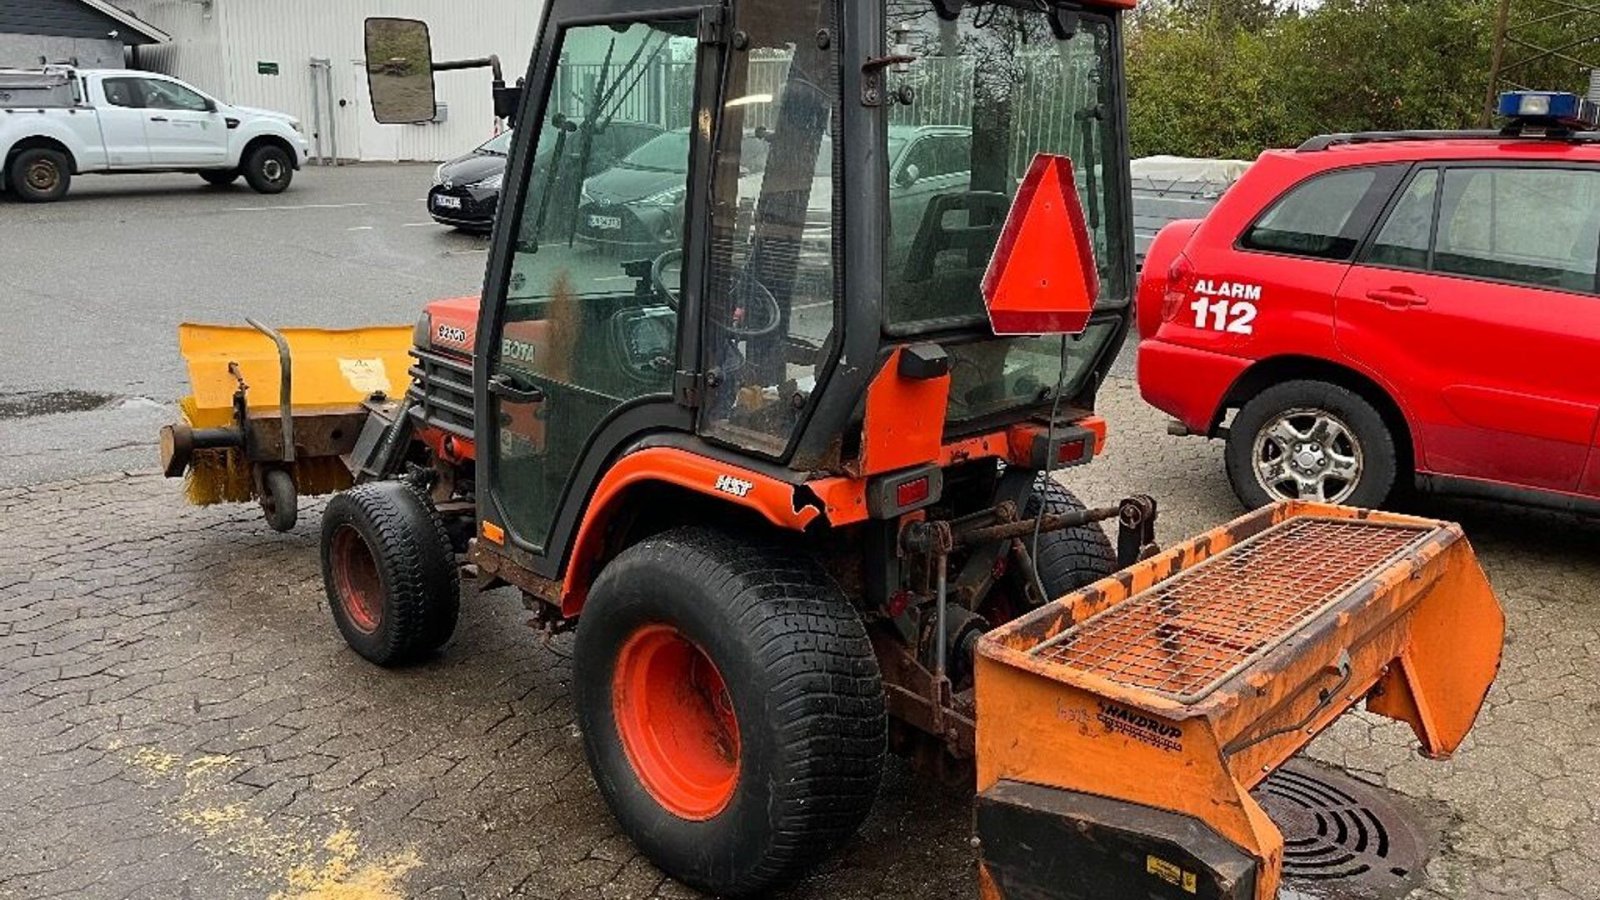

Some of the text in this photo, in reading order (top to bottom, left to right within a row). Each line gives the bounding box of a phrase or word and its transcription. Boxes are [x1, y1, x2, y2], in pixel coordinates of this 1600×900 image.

[1194, 279, 1262, 300] ALARM
[1190, 297, 1258, 335] 112
[501, 338, 536, 362] BOTA
[715, 474, 753, 497] HST
[1105, 703, 1183, 739] HAVDRUP
